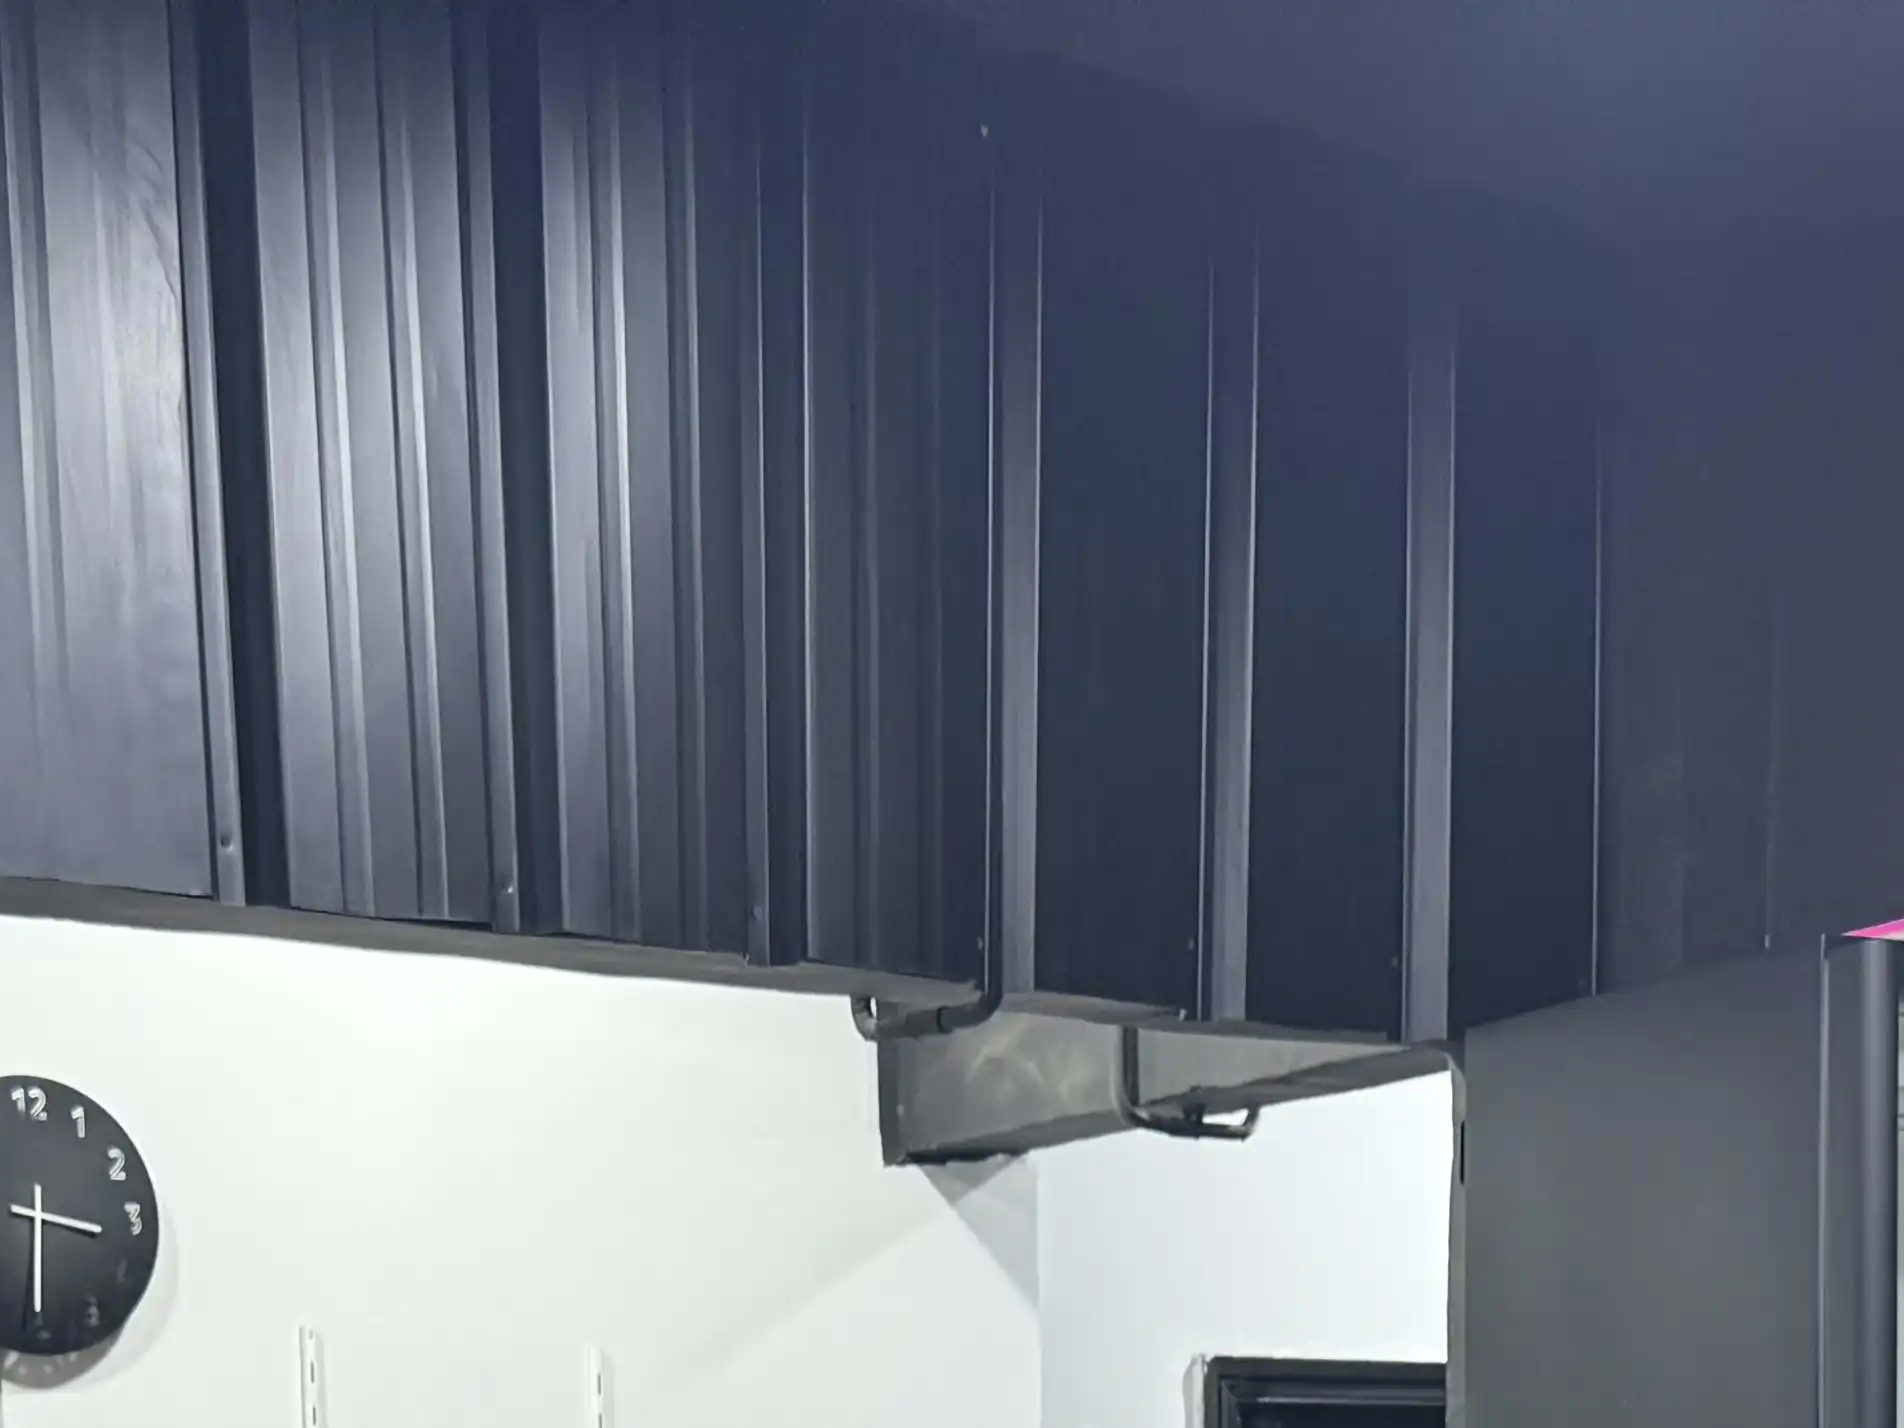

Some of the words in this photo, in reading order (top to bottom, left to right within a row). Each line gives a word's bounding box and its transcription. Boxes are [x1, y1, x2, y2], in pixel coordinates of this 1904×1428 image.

[10, 1086, 47, 1121] 12
[70, 1105, 86, 1138] 1
[106, 1146, 126, 1181] 2
[123, 1202, 142, 1236] 3
